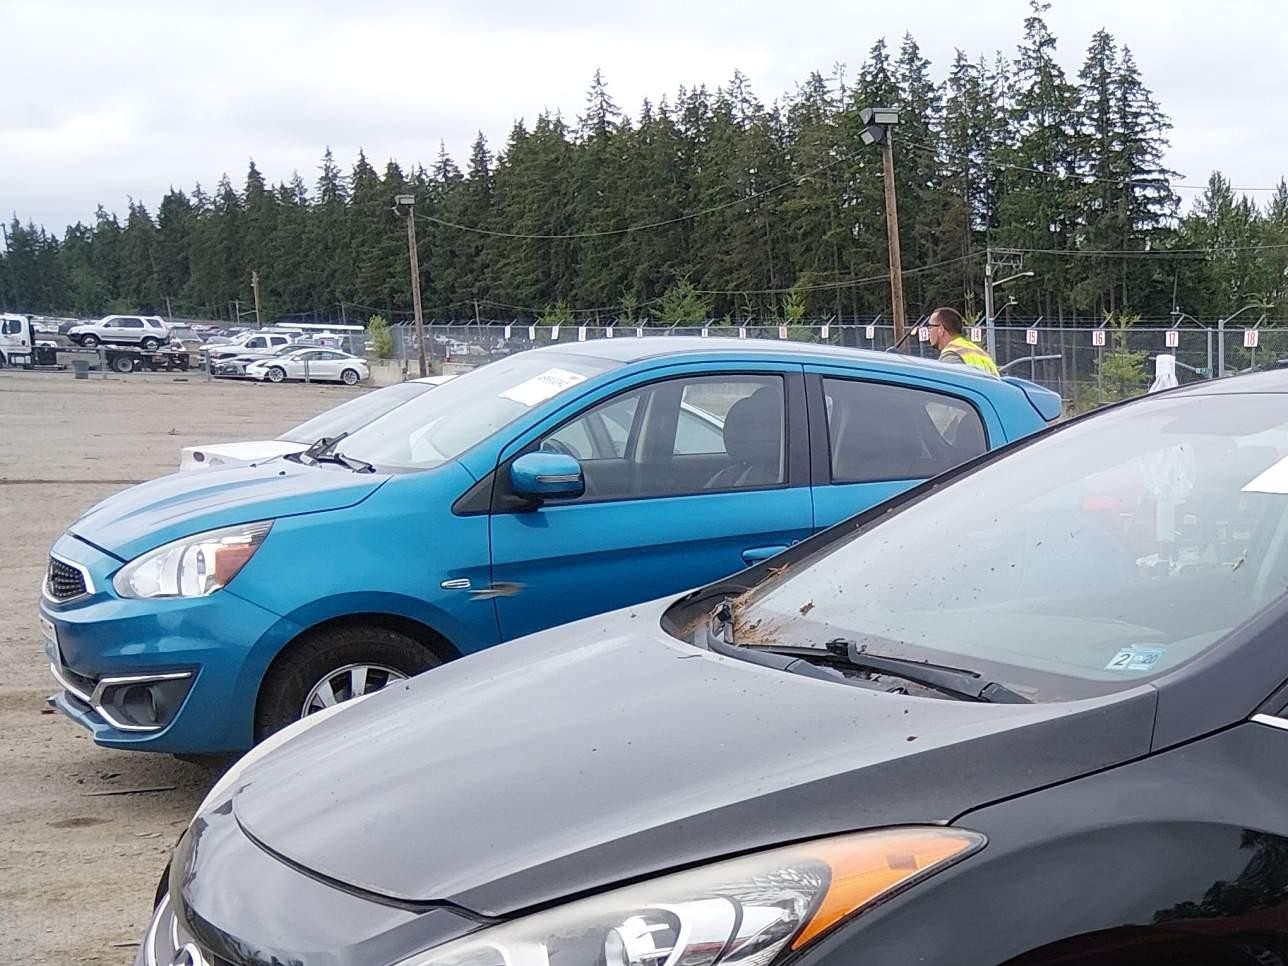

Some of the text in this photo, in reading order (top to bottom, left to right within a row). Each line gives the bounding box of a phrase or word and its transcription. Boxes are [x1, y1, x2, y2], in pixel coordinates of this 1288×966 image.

[1028, 331, 1036, 343] 15
[1095, 332, 1103, 344] 16
[1168, 333, 1176, 345] 17
[1246, 332, 1256, 346] 18
